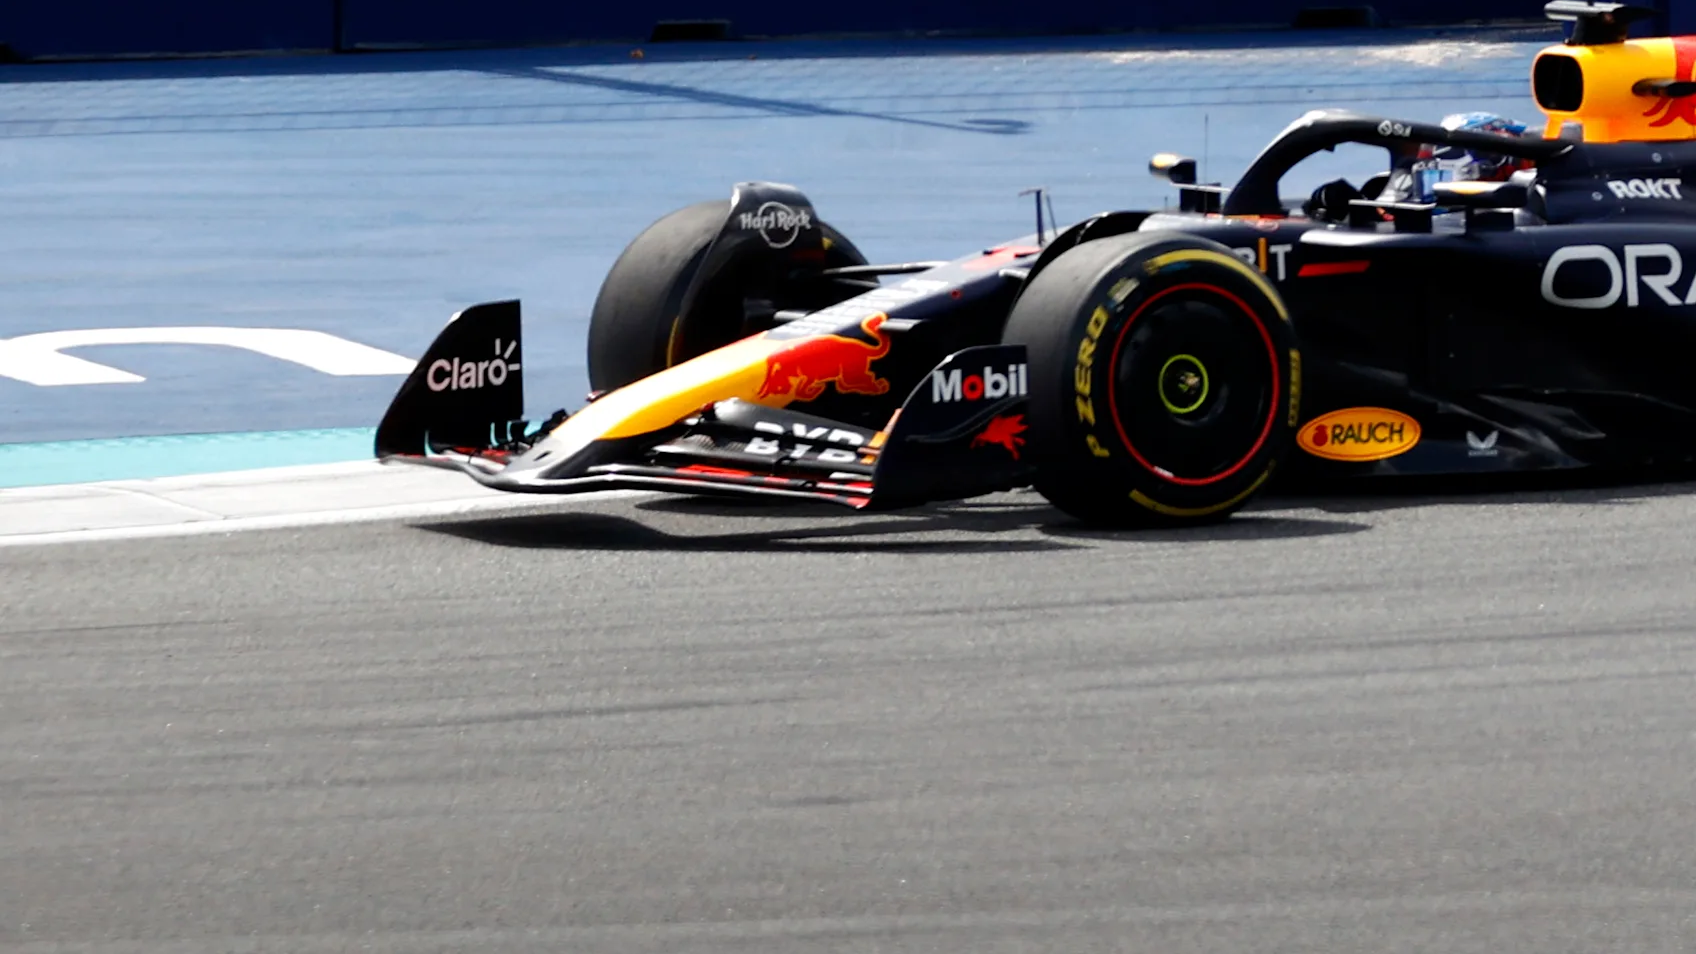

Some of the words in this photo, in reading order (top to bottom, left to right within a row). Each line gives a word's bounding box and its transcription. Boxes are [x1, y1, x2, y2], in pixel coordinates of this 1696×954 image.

[1607, 177, 1682, 200] ROKT
[427, 357, 508, 392] Claro
[932, 363, 1028, 403] Mobil
[1075, 305, 1110, 426] ZERO
[1331, 420, 1405, 446] RAUCH
